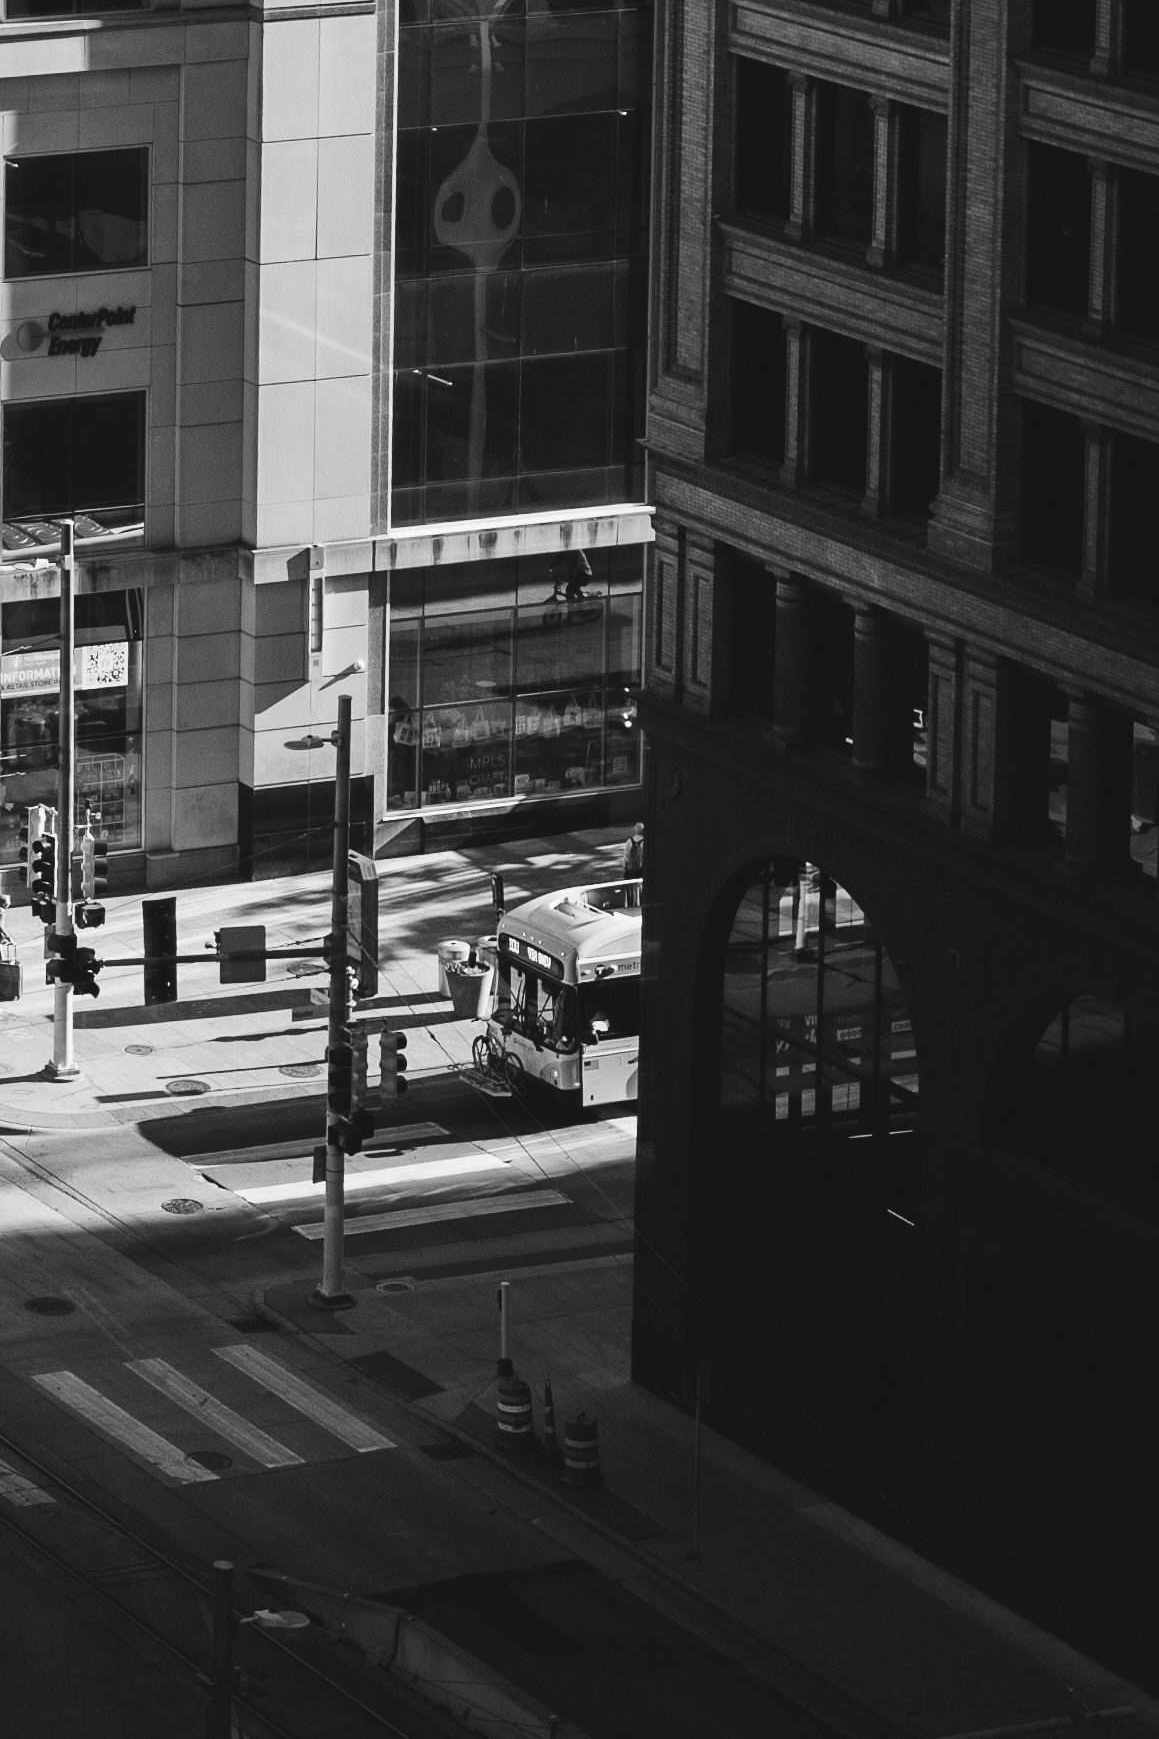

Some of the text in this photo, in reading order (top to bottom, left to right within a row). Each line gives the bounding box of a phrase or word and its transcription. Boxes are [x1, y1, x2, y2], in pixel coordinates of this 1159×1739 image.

[48, 306, 136, 331] CenterPoint
[48, 336, 103, 357] Energy
[470, 754, 506, 769] MPLS
[469, 771, 505, 784] CRAFT
